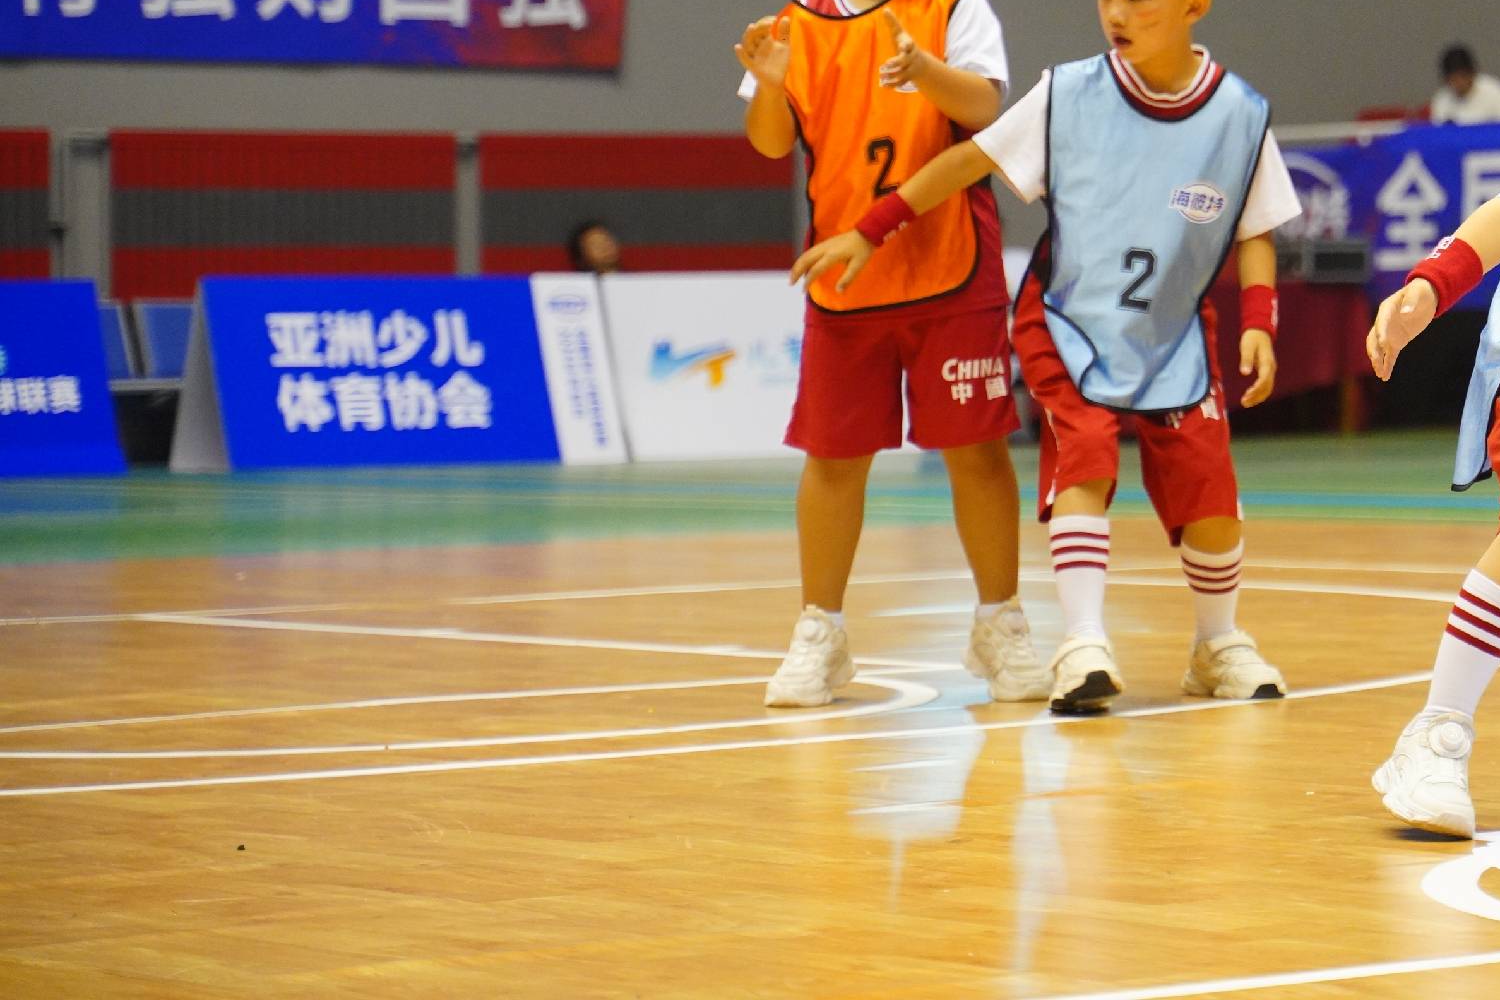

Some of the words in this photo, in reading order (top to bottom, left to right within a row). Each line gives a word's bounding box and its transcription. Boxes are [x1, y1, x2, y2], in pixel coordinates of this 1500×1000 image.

[866, 136, 898, 197] 2
[1117, 247, 1157, 314] 2
[265, 309, 485, 368] 亚洲少儿
[941, 357, 1005, 382] CHINA
[277, 371, 493, 433] 体育协会
